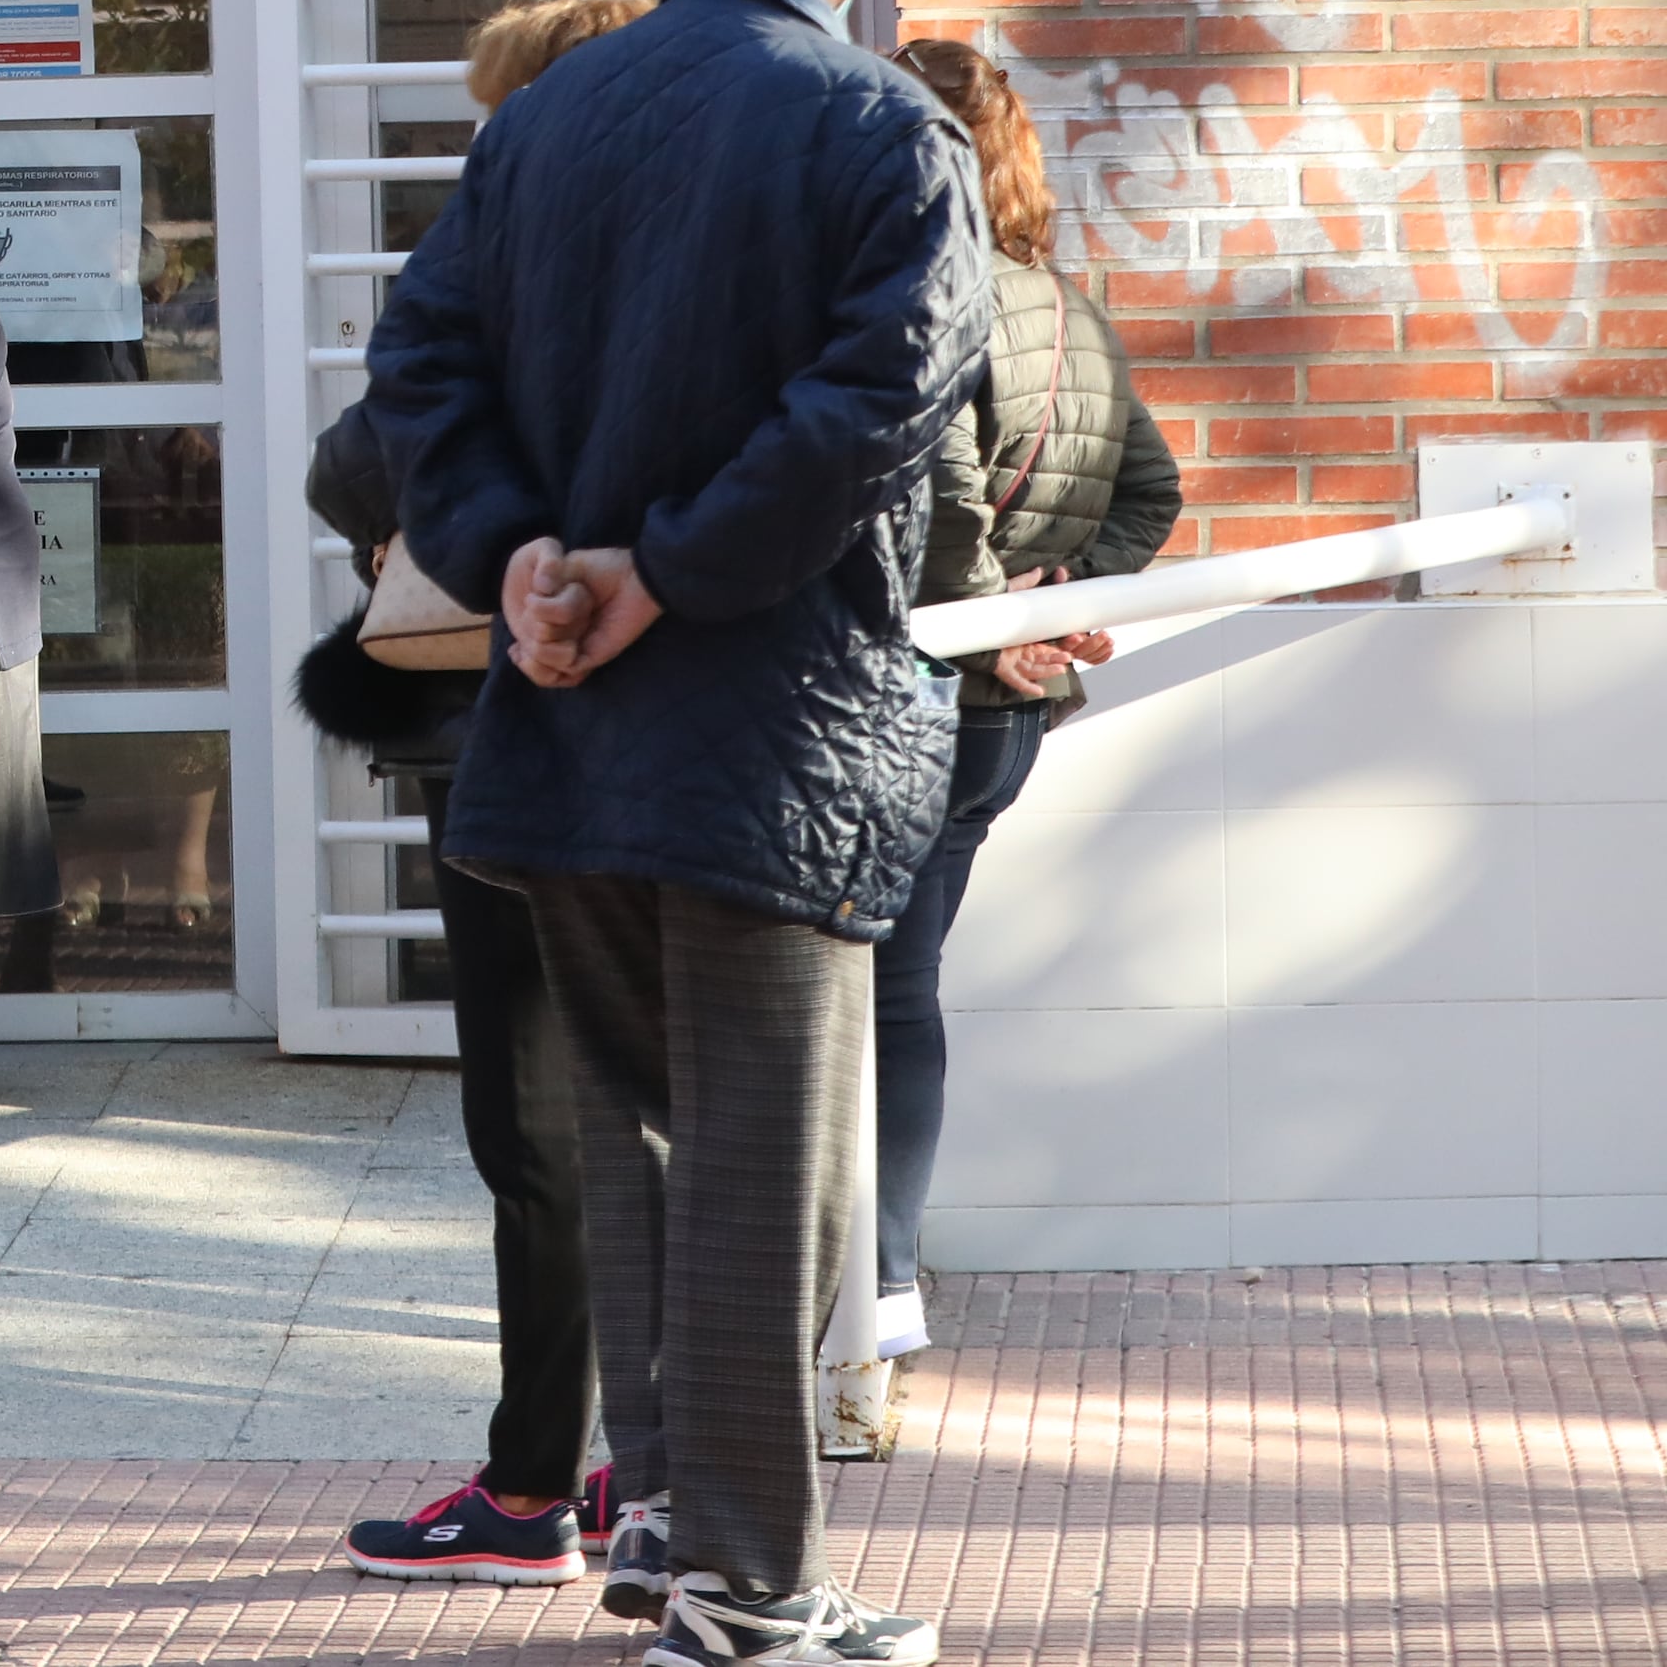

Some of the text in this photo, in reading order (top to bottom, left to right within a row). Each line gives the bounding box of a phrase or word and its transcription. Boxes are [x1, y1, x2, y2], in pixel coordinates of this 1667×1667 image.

[24, 171, 99, 180] RESPIRATORIOS
[44, 200, 91, 208] MIENTRAS
[93, 198, 118, 208] ESTÉ
[6, 210, 57, 218] SANITARIO
